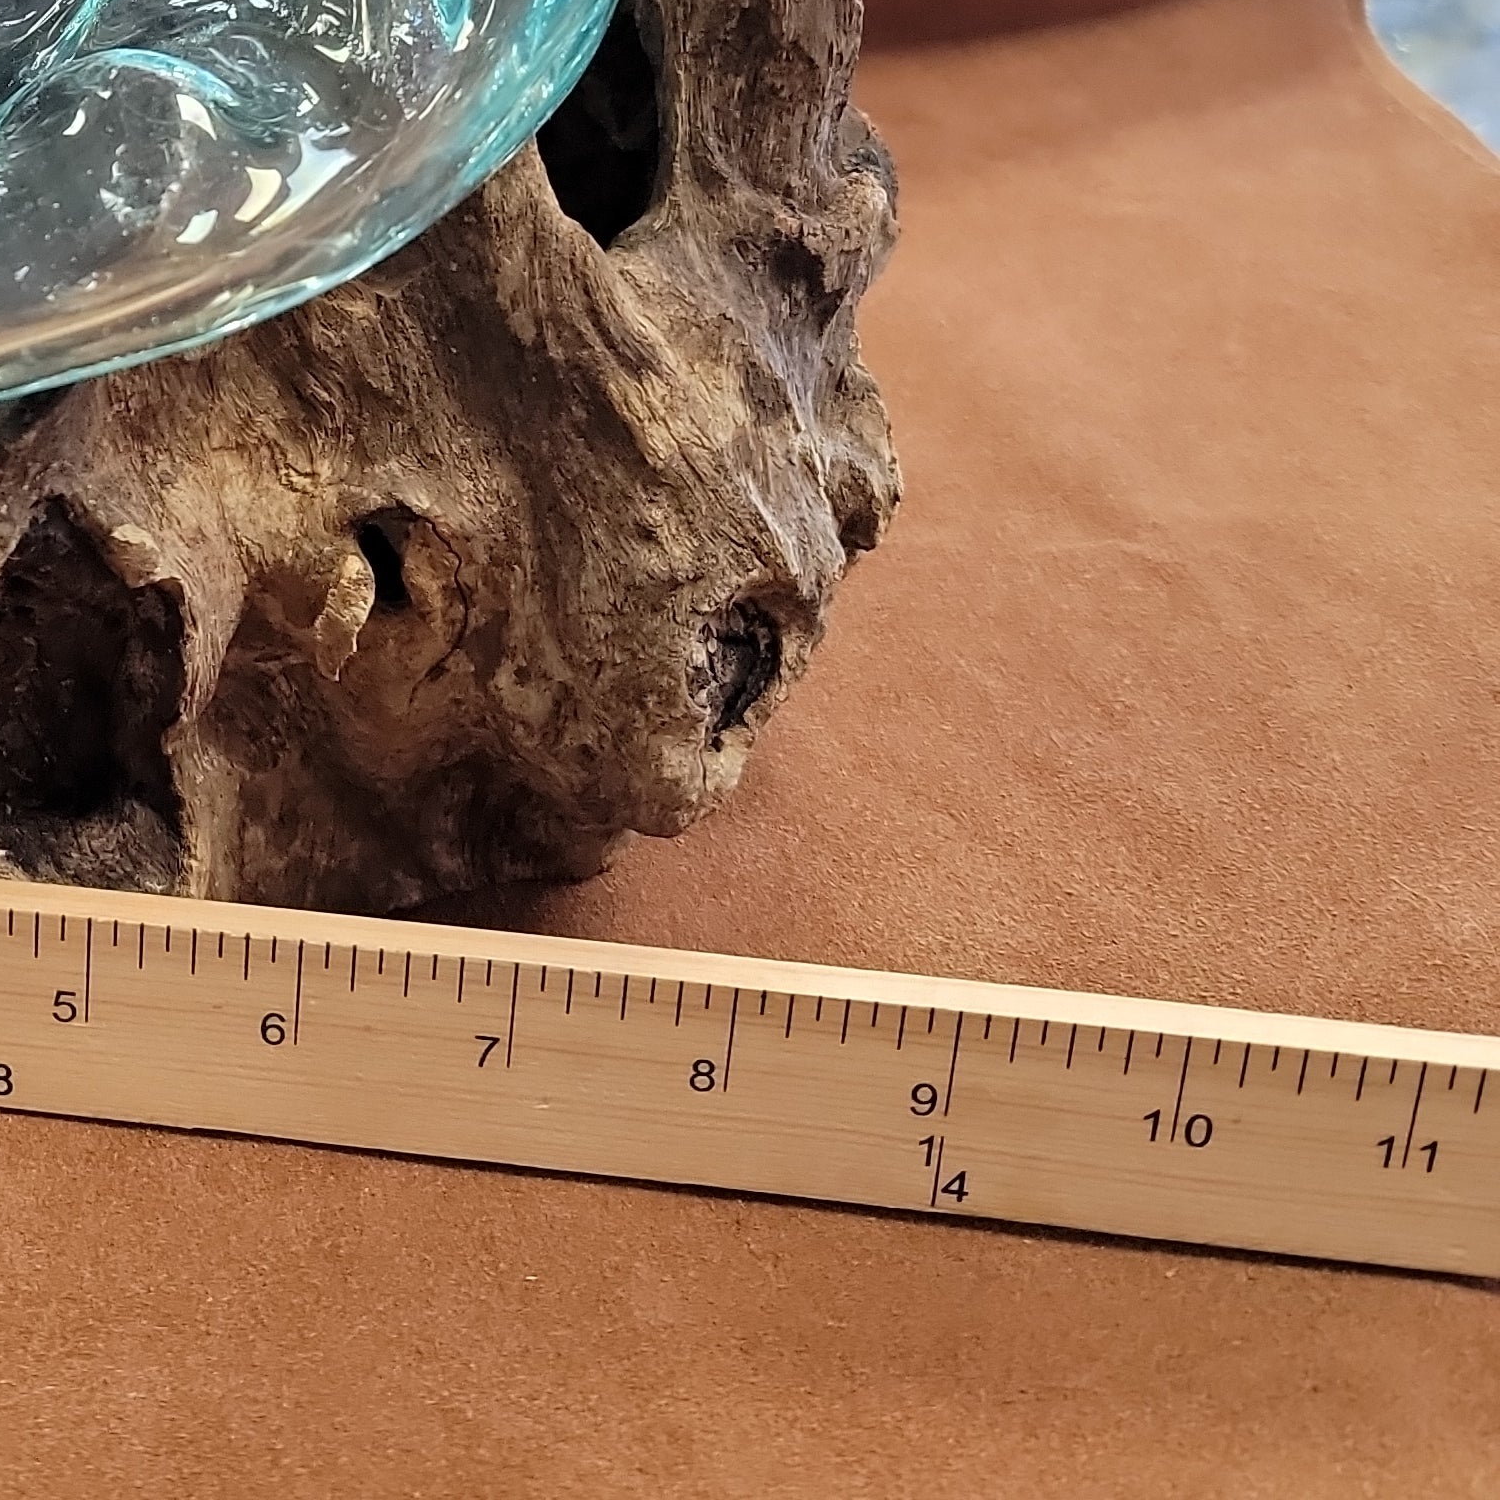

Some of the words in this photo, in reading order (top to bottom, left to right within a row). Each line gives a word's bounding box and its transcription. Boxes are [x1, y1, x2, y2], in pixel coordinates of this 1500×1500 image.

[51, 989, 77, 1023] 5
[260, 1012, 287, 1046] 6
[474, 1034, 501, 1068] 7
[689, 1058, 717, 1093] 8
[909, 1082, 938, 1117] 9
